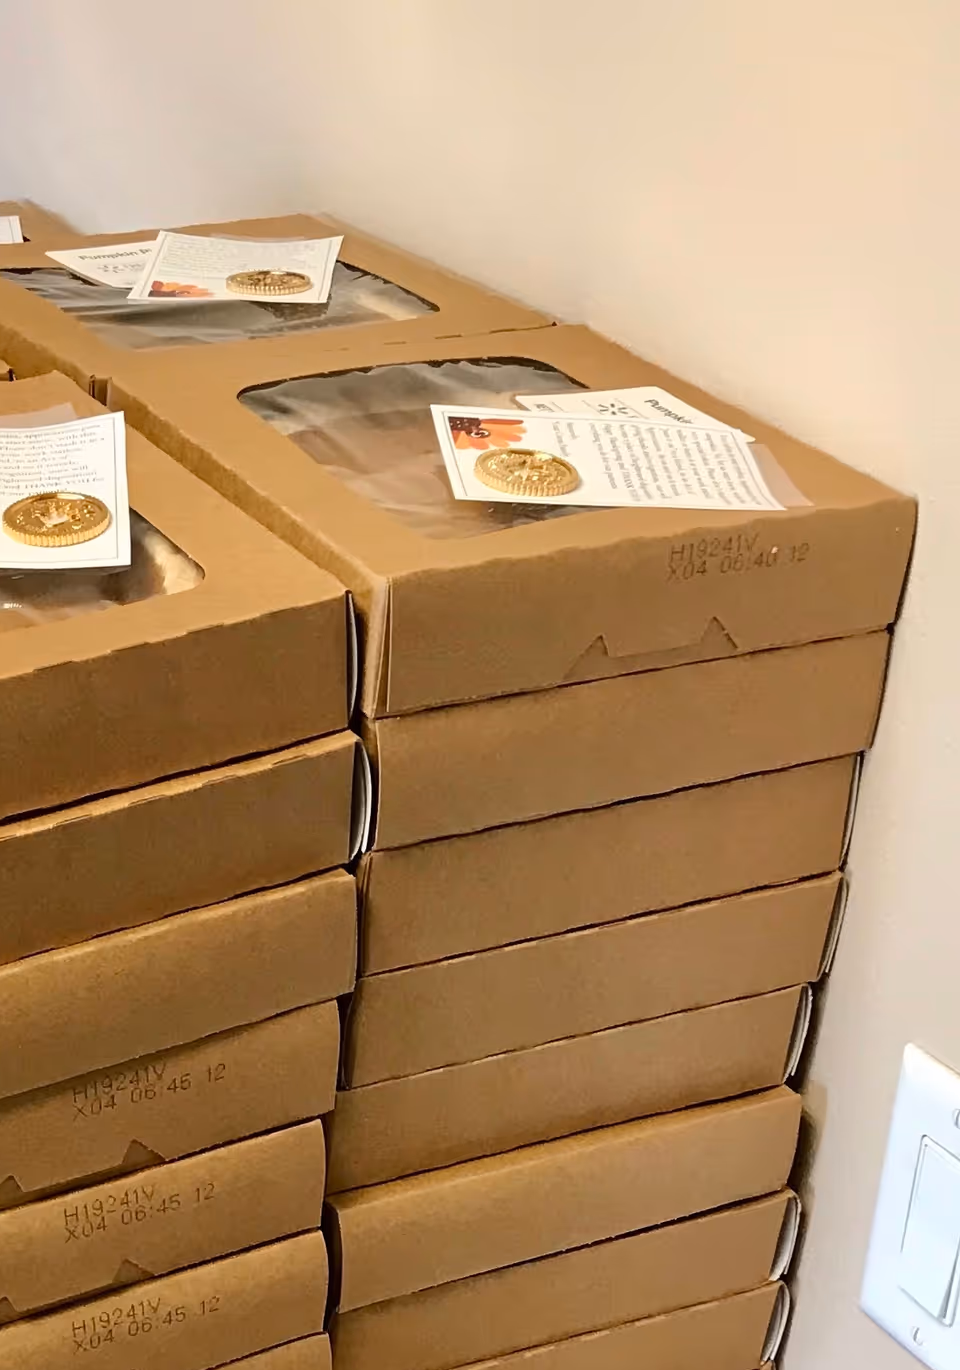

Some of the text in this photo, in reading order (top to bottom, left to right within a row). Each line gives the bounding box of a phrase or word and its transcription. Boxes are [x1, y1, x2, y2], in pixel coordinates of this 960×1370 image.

[72, 1062, 166, 1104] H19241V
[73, 1095, 117, 1122] X04
[207, 1063, 226, 1083] 12
[64, 1185, 154, 1226] H19241V
[65, 1184, 216, 1244] X04 06:45 12
[72, 1297, 161, 1338] H19241V
[73, 1296, 220, 1354] X04 06:45 12
